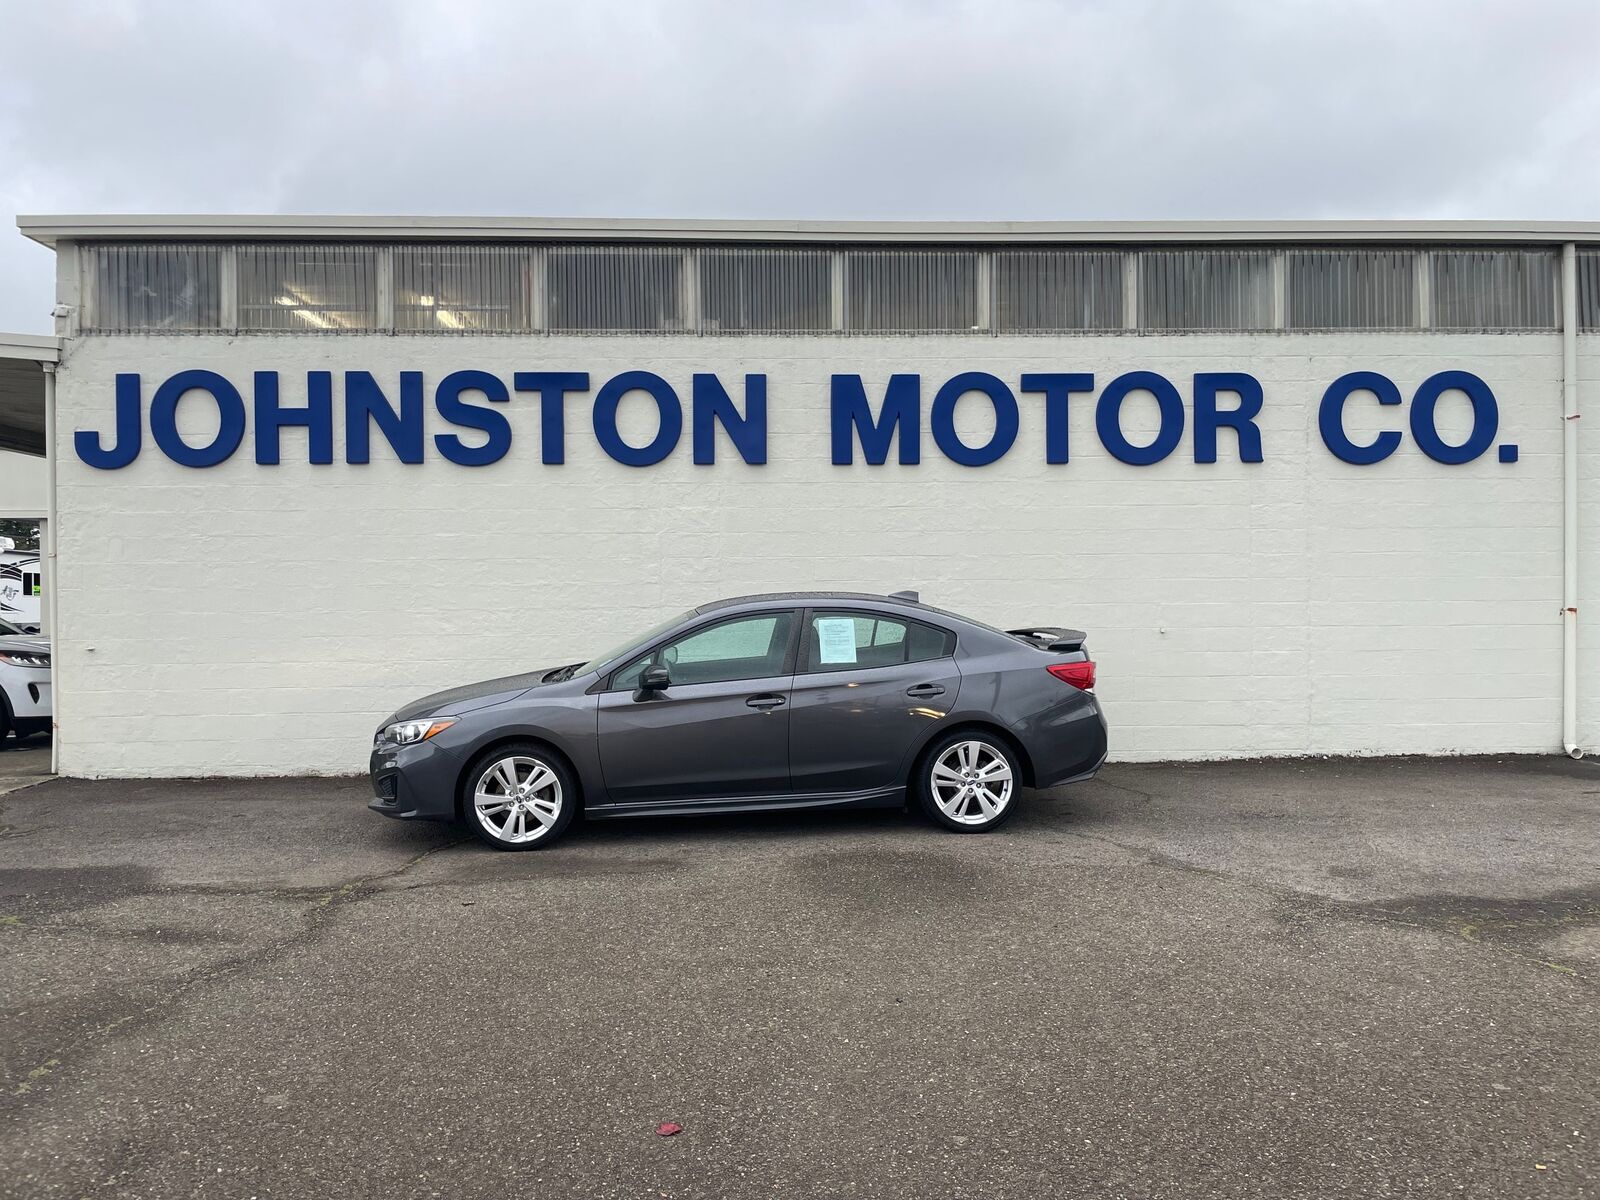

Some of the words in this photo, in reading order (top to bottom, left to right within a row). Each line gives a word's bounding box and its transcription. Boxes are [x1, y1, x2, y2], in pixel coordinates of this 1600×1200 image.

[74, 369, 767, 471] JOHNSTON
[830, 371, 1264, 468] MOTOR
[1318, 370, 1519, 466] CO.
